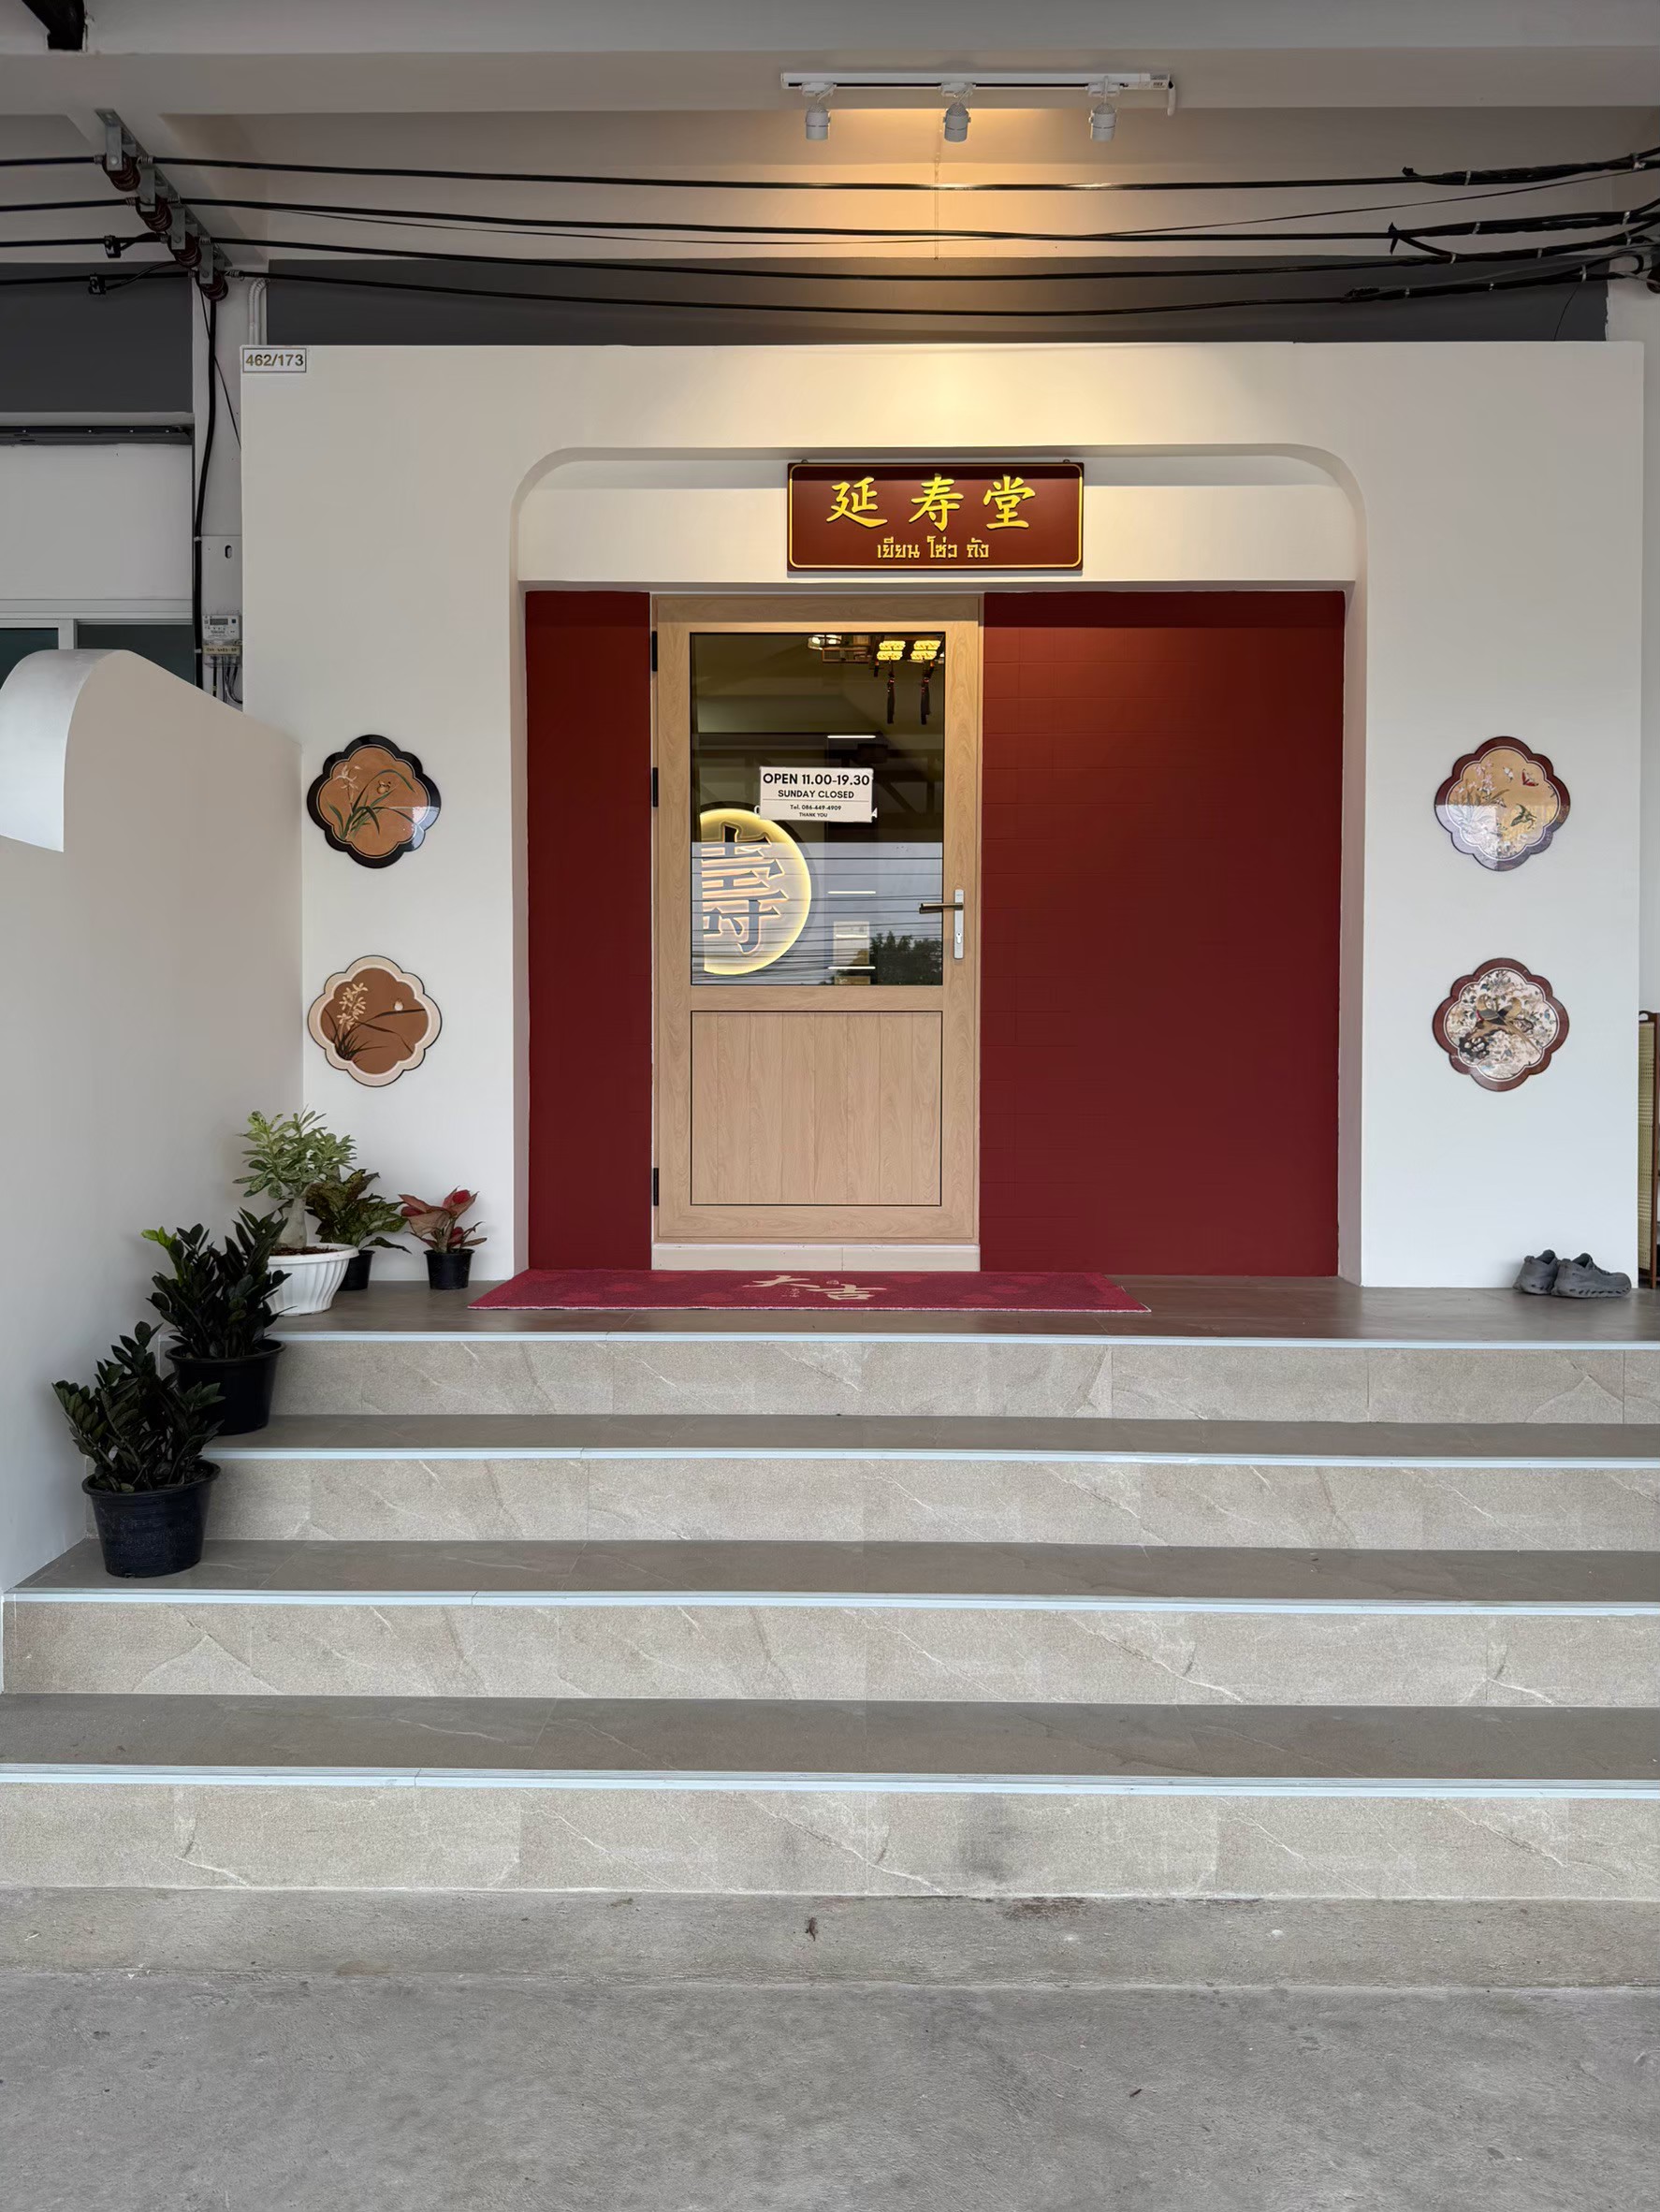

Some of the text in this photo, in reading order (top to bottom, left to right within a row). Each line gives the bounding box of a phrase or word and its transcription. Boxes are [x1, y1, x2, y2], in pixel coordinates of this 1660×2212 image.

[245, 354, 304, 366] 462/173
[825, 473, 1036, 531] 延寿堂
[877, 536, 920, 559] เยียน
[763, 773, 870, 786] OPEN 11.00-19.30
[778, 790, 854, 799] SUNDAY CLOSED
